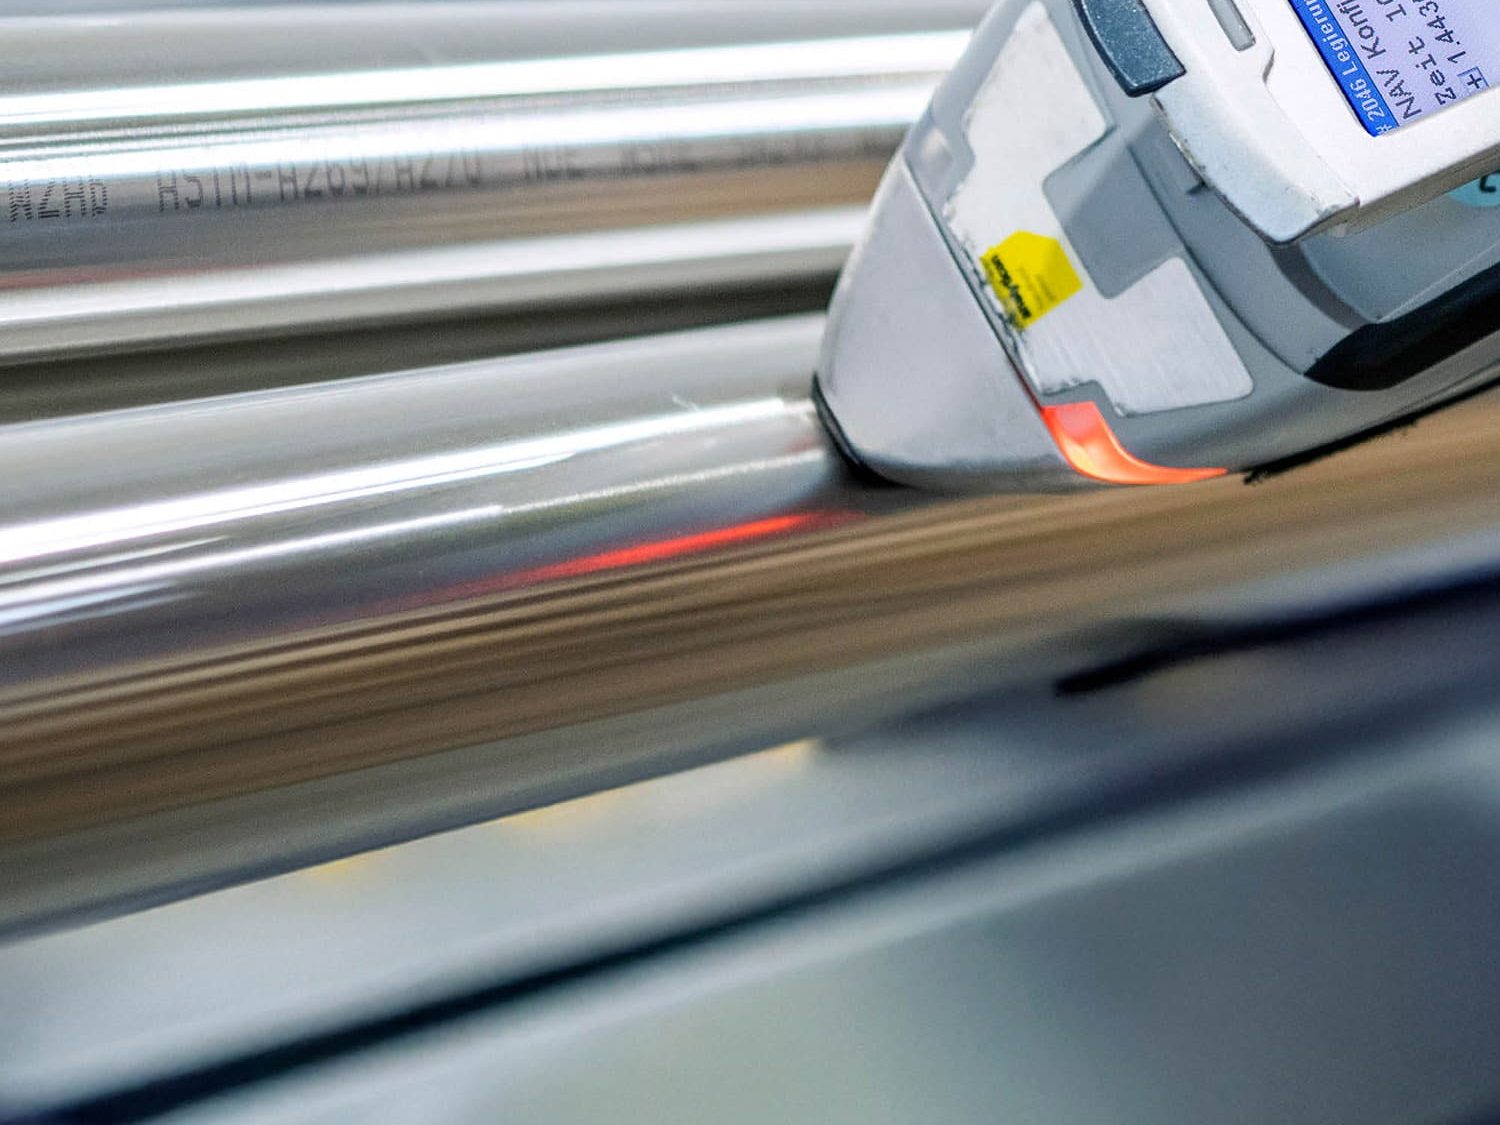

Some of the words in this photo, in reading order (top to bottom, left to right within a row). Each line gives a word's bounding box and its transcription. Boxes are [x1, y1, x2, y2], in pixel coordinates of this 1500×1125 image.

[1374, 68, 1422, 120] NAV
[1407, 35, 1457, 106] Zeit
[1349, 77, 1385, 121] 2046
